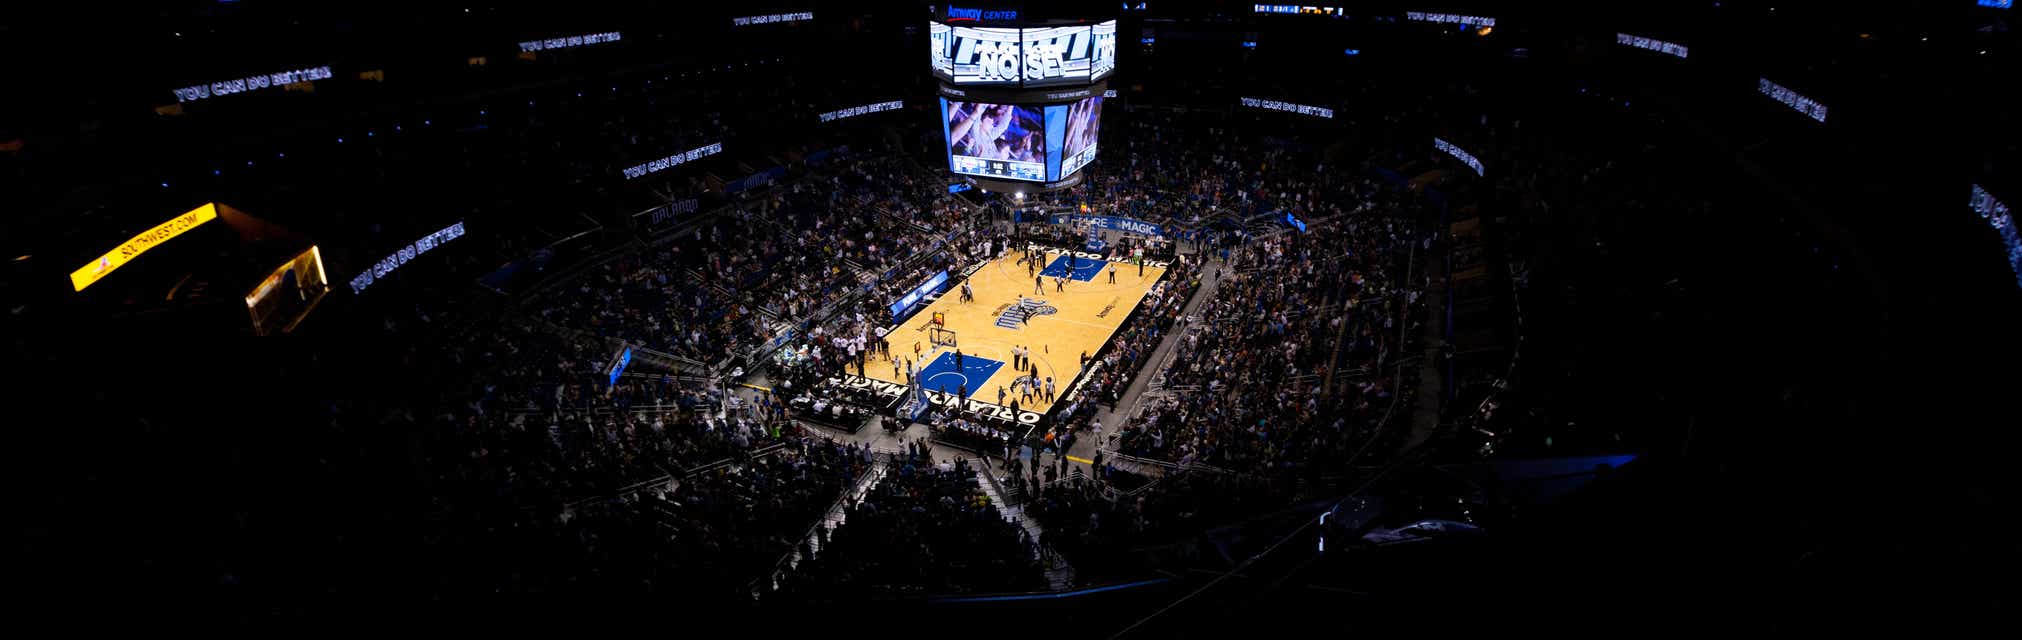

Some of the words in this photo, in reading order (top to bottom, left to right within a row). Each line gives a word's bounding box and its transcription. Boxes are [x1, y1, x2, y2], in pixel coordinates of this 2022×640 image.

[948, 4, 981, 21] Amway
[984, 11, 1017, 20] CENTER
[173, 85, 210, 102] YOU
[211, 79, 247, 96] CAN
[247, 75, 270, 90] DO
[271, 66, 332, 86] BETTER
[1241, 97, 1260, 107] YOU
[819, 111, 836, 123] YOU
[623, 164, 646, 179] YOU
[648, 157, 669, 172] CAN
[670, 153, 685, 166] DO
[686, 142, 722, 161] BETTER
[121, 213, 198, 259] SOUTHWEST.COM
[1121, 220, 1156, 235] MAGIC
[350, 269, 373, 294] YOU
[373, 254, 399, 278] CAN
[398, 245, 416, 264] DO
[415, 221, 465, 254] BETTER
